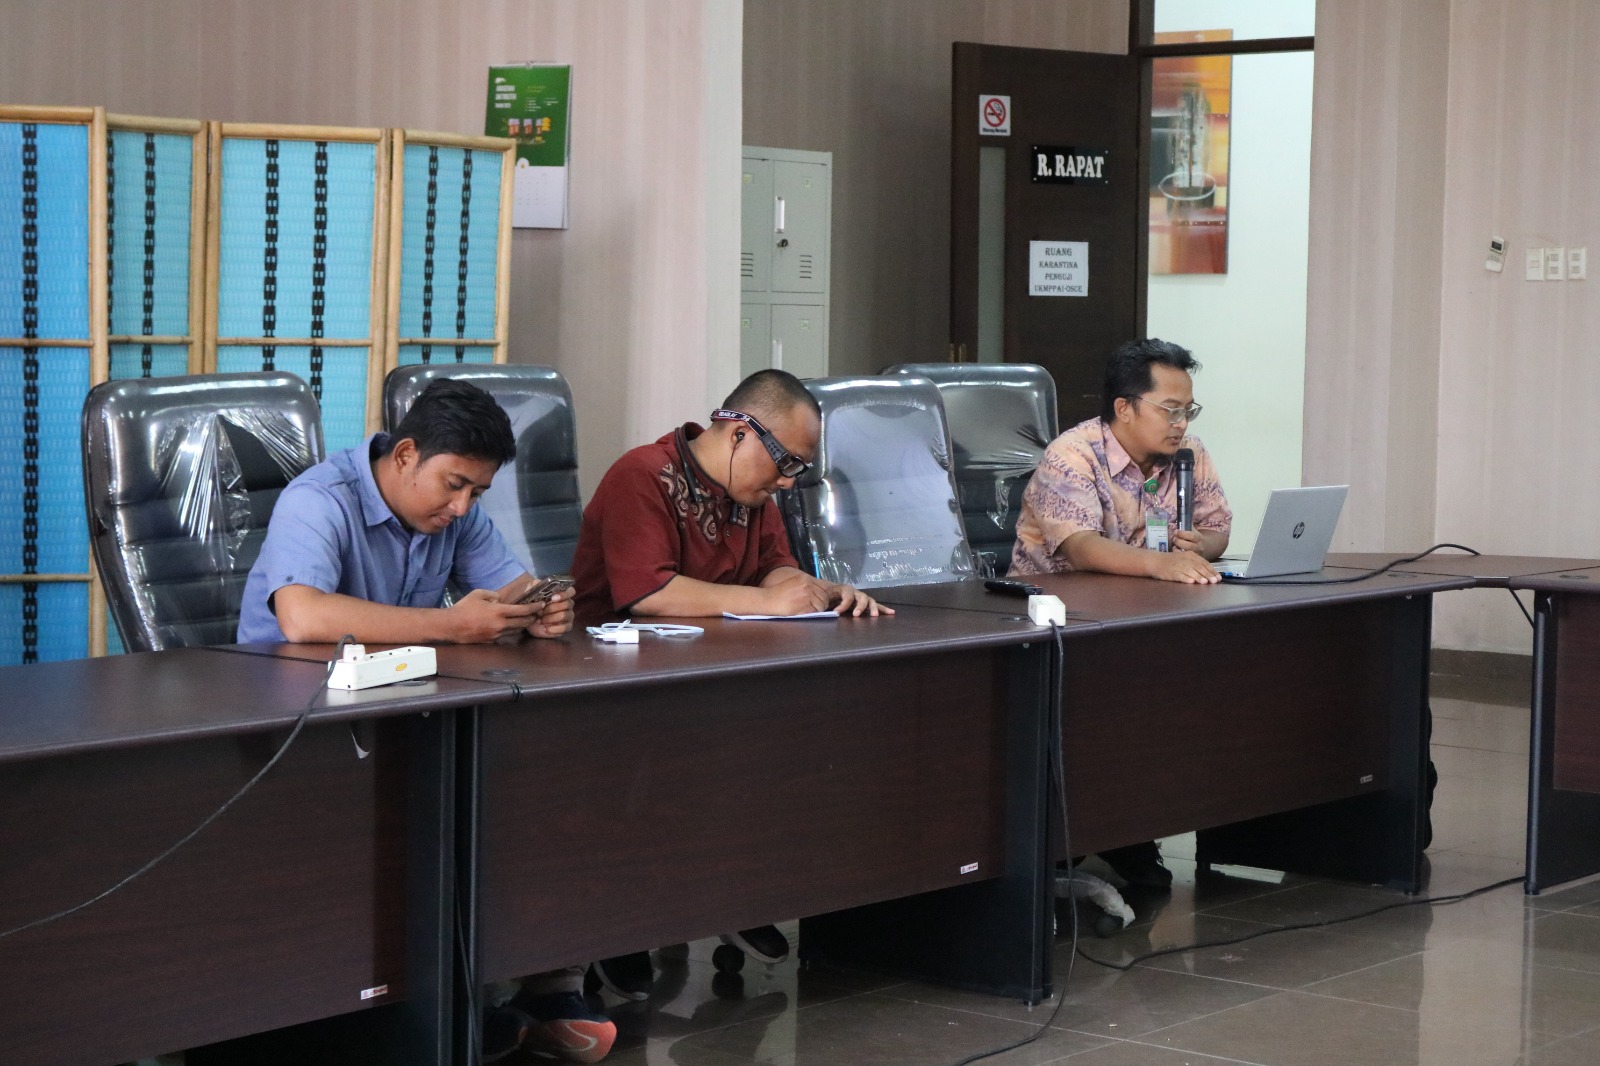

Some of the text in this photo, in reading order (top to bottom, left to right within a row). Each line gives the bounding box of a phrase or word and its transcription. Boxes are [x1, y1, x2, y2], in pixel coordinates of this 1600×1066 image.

[1037, 153, 1104, 178] R. RAPAT
[1045, 247, 1072, 256] RUANG
[1039, 260, 1078, 269] KARANTINA
[1045, 272, 1072, 281] PENGUJI
